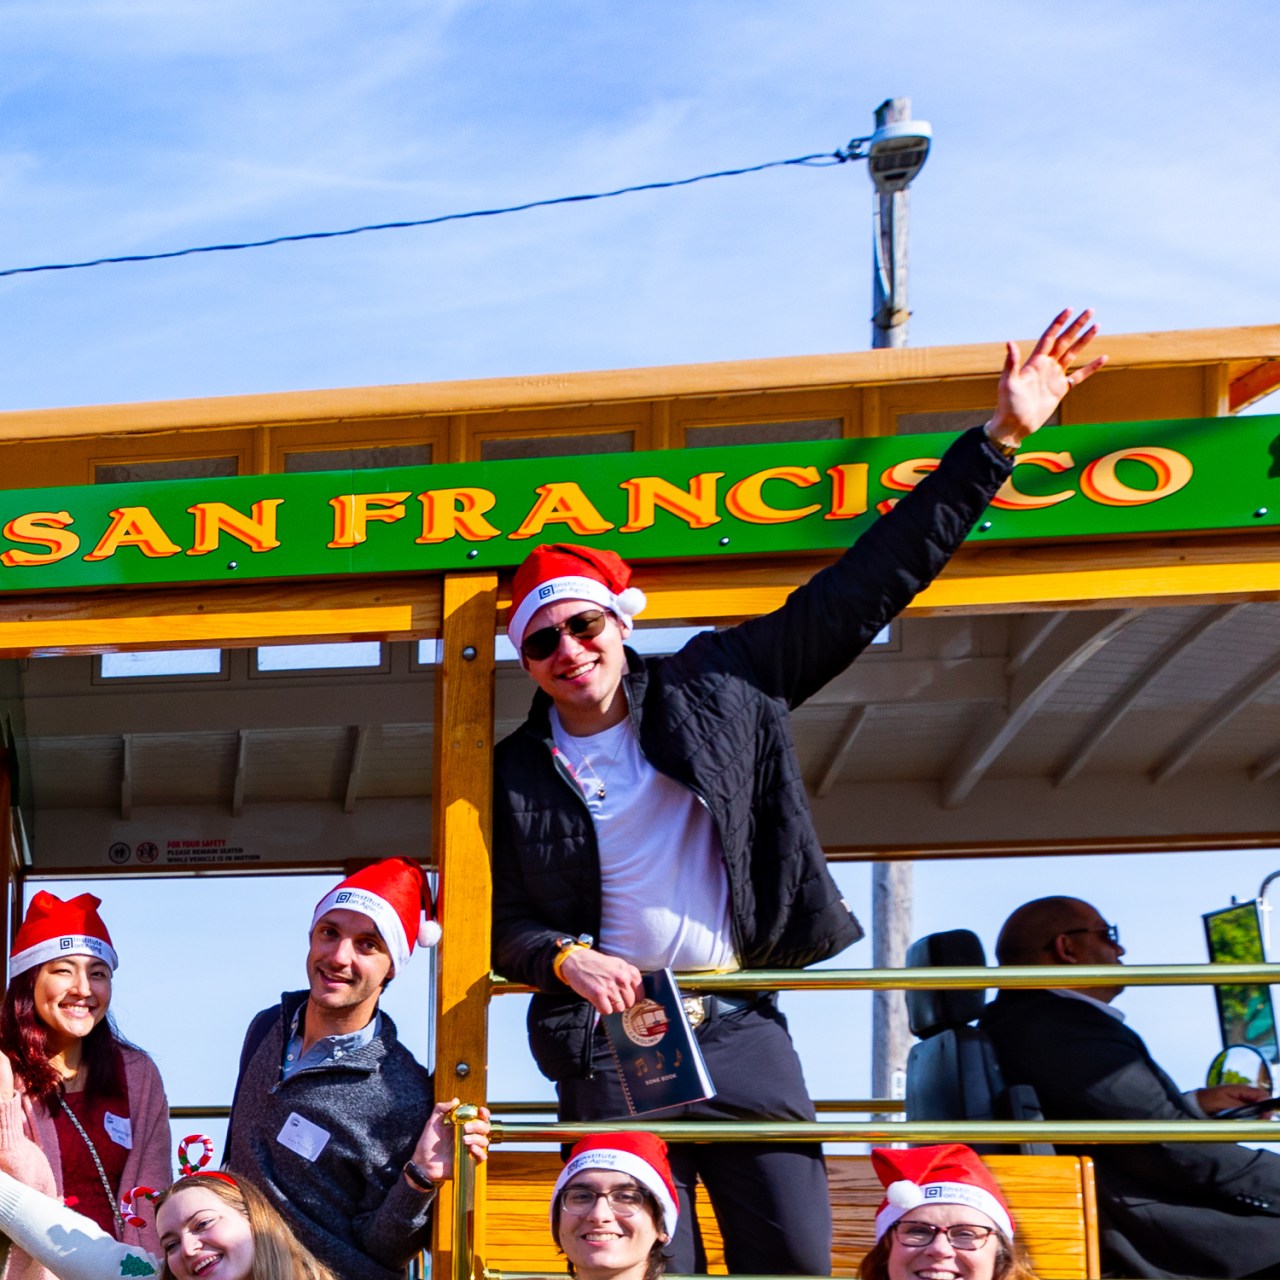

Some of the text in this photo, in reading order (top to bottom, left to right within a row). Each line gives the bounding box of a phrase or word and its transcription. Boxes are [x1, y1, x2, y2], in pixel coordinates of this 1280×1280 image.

[0, 498, 285, 567] SAN
[167, 839, 226, 849] FOR YOUR SAFETY
[167, 848, 191, 856] PLEASE
[189, 855, 216, 863] VEHICLE
[645, 1073, 677, 1086] SONG BOOK
